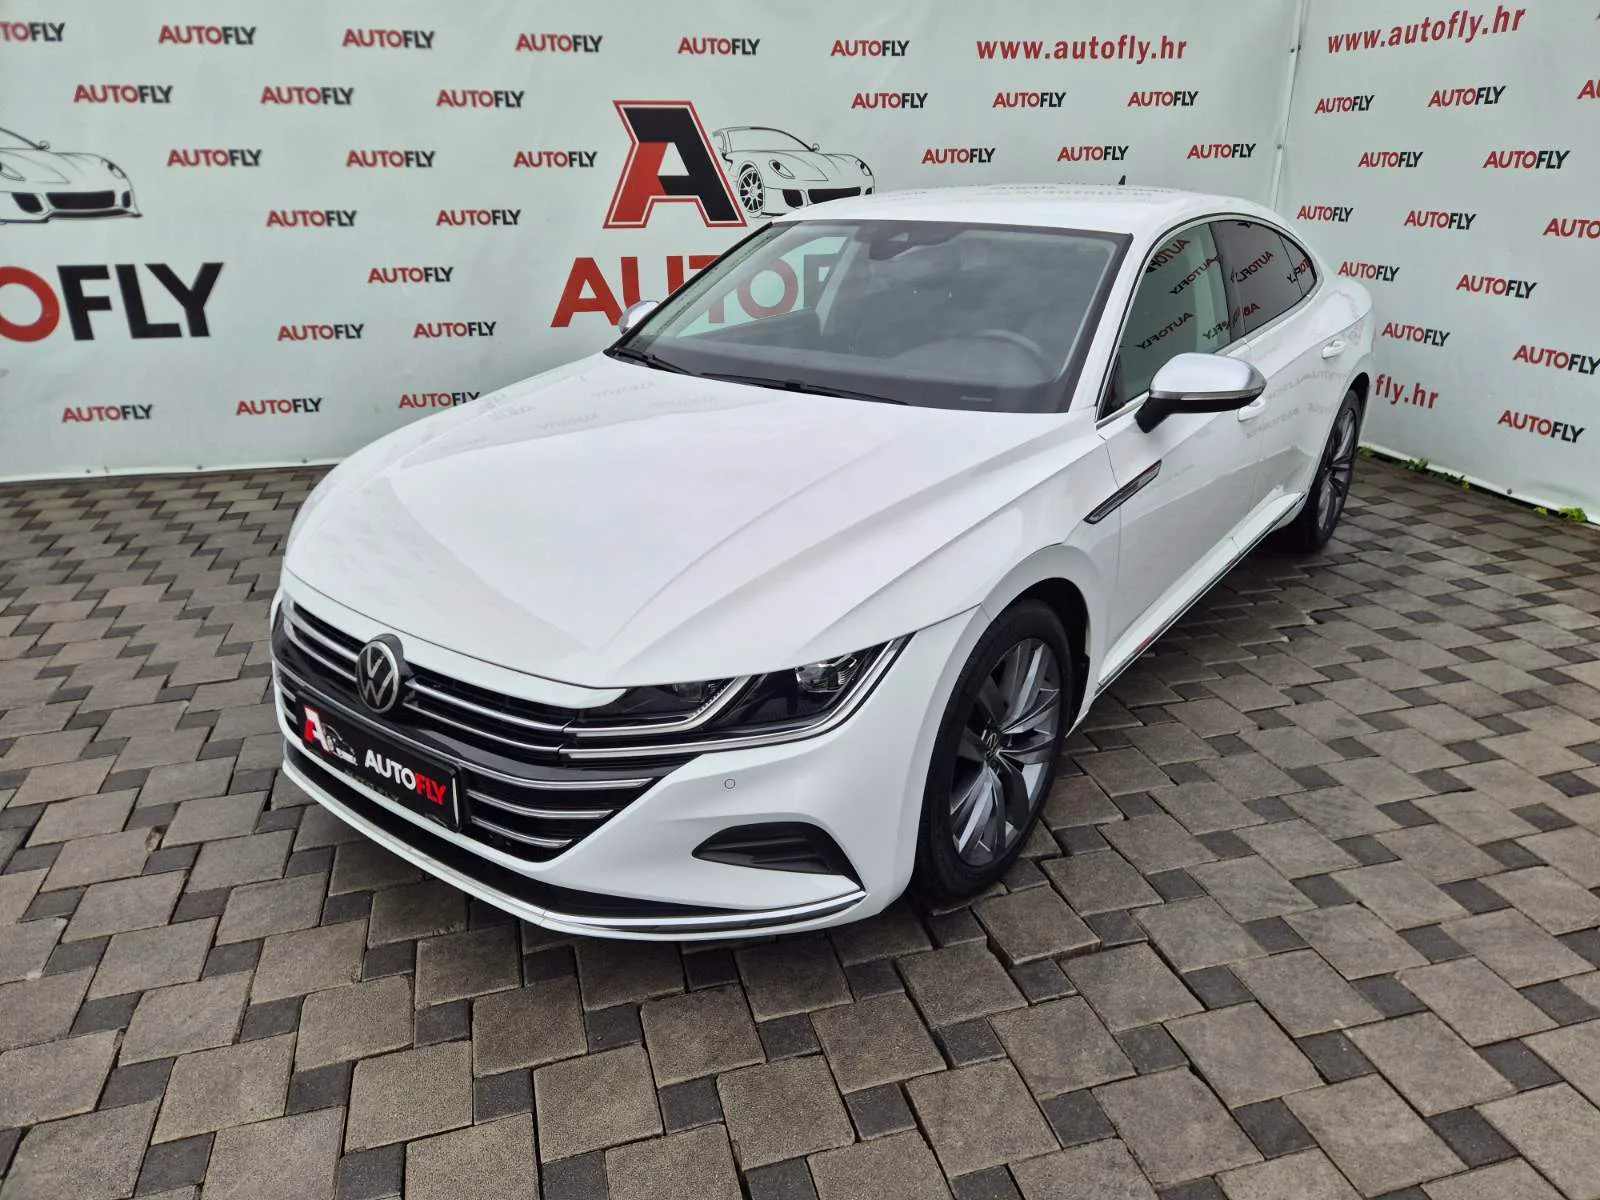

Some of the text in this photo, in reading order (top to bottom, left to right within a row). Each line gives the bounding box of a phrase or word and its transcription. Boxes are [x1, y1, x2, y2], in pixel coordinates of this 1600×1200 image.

[158, 25, 257, 46] AUTOFLY
[342, 29, 435, 49] AUTOFLY
[1327, 5, 1527, 54] www.autofly.hr
[515, 33, 604, 53] AUTOFLY
[677, 37, 761, 56] AUTOFLY
[830, 39, 911, 57] AUTOFLY
[976, 34, 1188, 65] www.autofly.hr
[73, 84, 174, 104] AUTOFLY
[260, 86, 355, 106] AUTOFLY
[436, 90, 525, 109] AUTOFLY
[1127, 91, 1200, 108] AUTOFLY
[1427, 85, 1507, 108] AUTOFLY
[1577, 79, 1600, 100] A
[851, 92, 929, 110] AUTOFLY
[992, 92, 1067, 109] AUTOFLY
[1314, 94, 1376, 114] AUTOFLY
[167, 149, 263, 168] AUTOFLY
[346, 150, 436, 169] AUTOFLY
[512, 151, 598, 169] AUTOFLY
[921, 148, 996, 165] AUTOFLY
[1056, 145, 1130, 162] AUTOFLY
[1187, 143, 1257, 159] AUTOFLY
[1357, 151, 1424, 169] AUTOFLY
[1482, 150, 1571, 170] AUTOFLY
[266, 210, 358, 228] AUTOFLY
[435, 209, 522, 227] AUTOFLY
[1296, 205, 1355, 223] AUTOFLY
[1404, 210, 1477, 231] AUTOFLY
[367, 267, 454, 284] AUTOFLY
[1338, 261, 1401, 283] AUTOFLY
[1455, 274, 1538, 300] AUTOFLY
[277, 323, 365, 342] AUTOFLY
[413, 321, 497, 339] AUTOFLY
[1381, 322, 1451, 348] AUTOFLY
[1512, 345, 1600, 376] AUTOFLY
[62, 404, 153, 424] AUTOFLY
[235, 397, 323, 417] AUTOFLY
[1497, 410, 1585, 444] AUTOFLY
[364, 749, 448, 806] AUTOFLY
